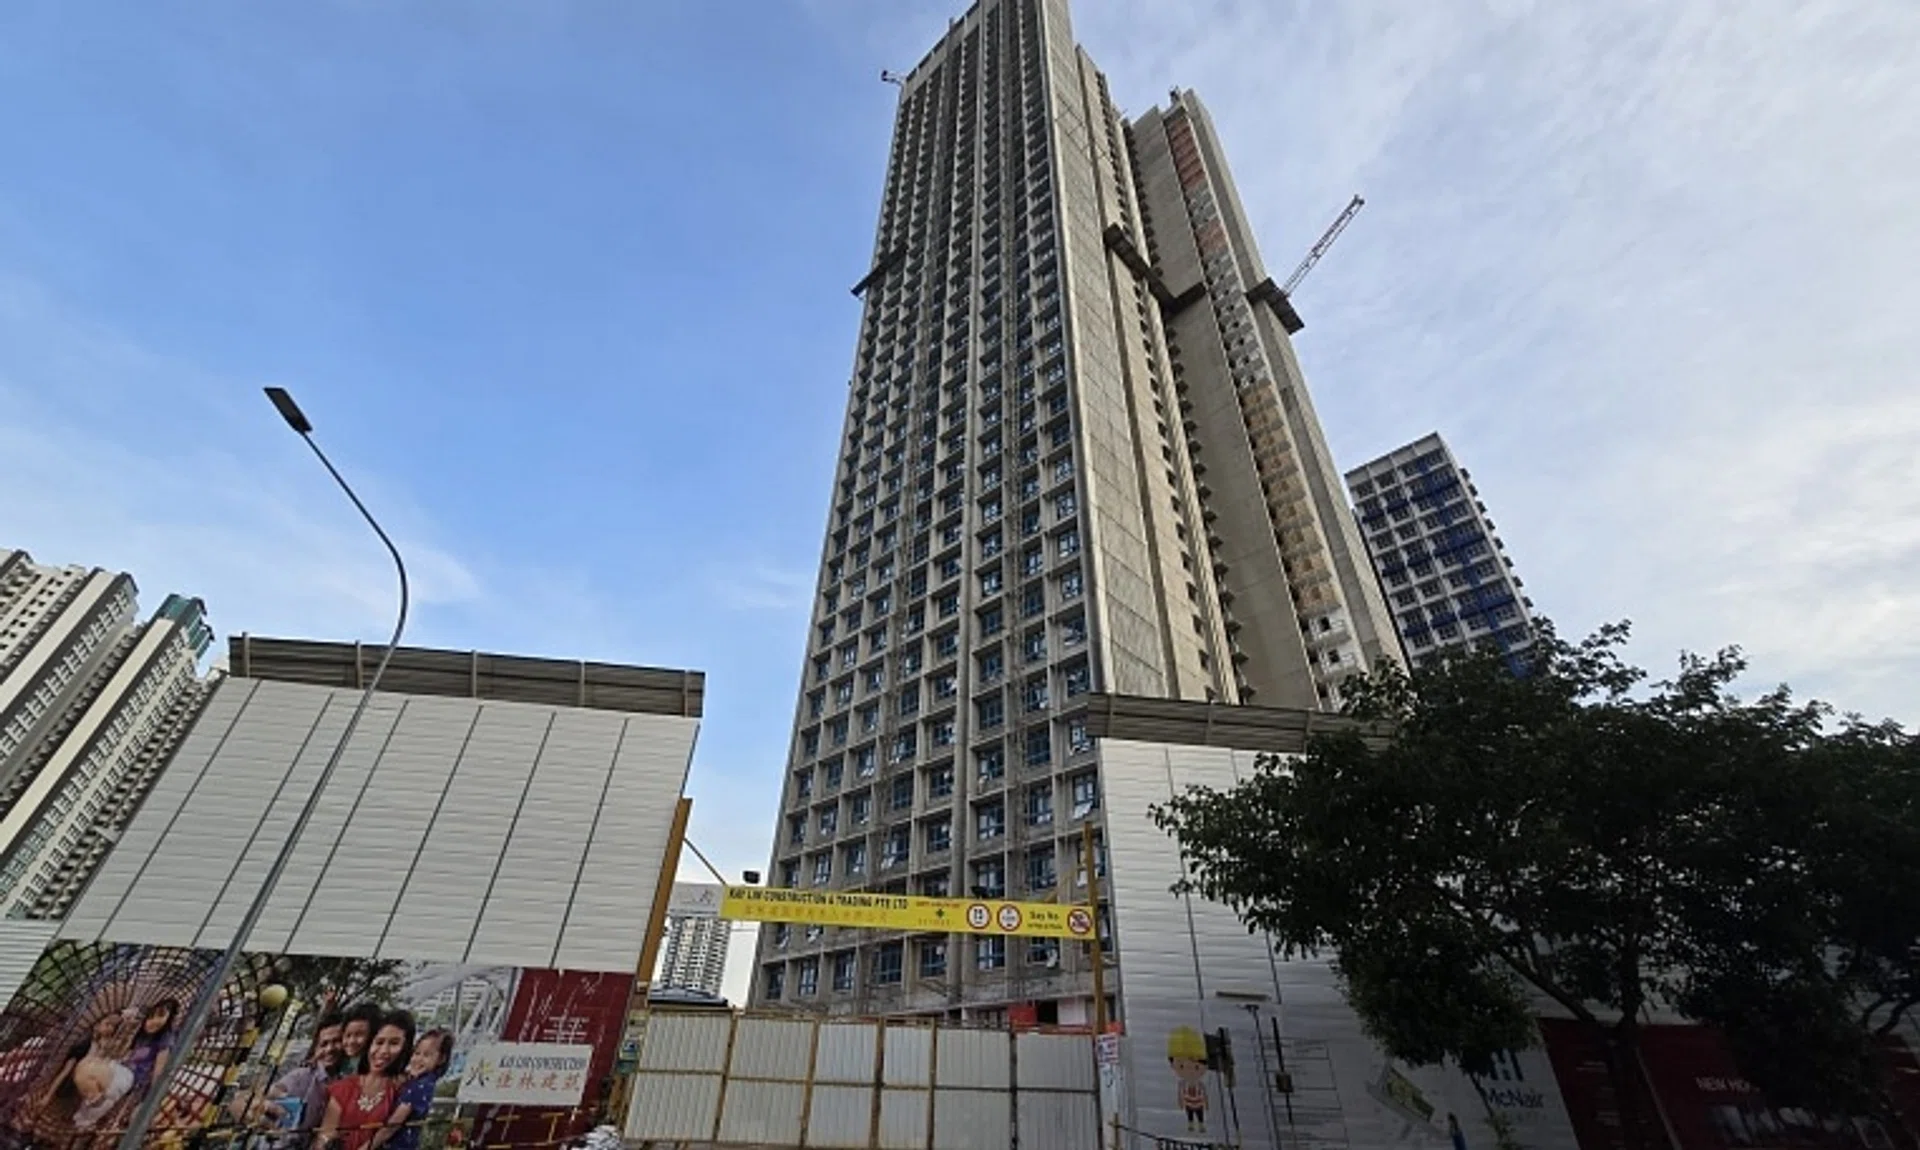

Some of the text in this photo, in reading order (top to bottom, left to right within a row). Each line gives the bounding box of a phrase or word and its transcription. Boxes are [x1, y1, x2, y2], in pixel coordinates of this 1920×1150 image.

[764, 889, 826, 905] CONSTRUCTION
[837, 895, 873, 907] TRADING
[875, 897, 890, 909] PTE
[893, 898, 908, 910] LTD
